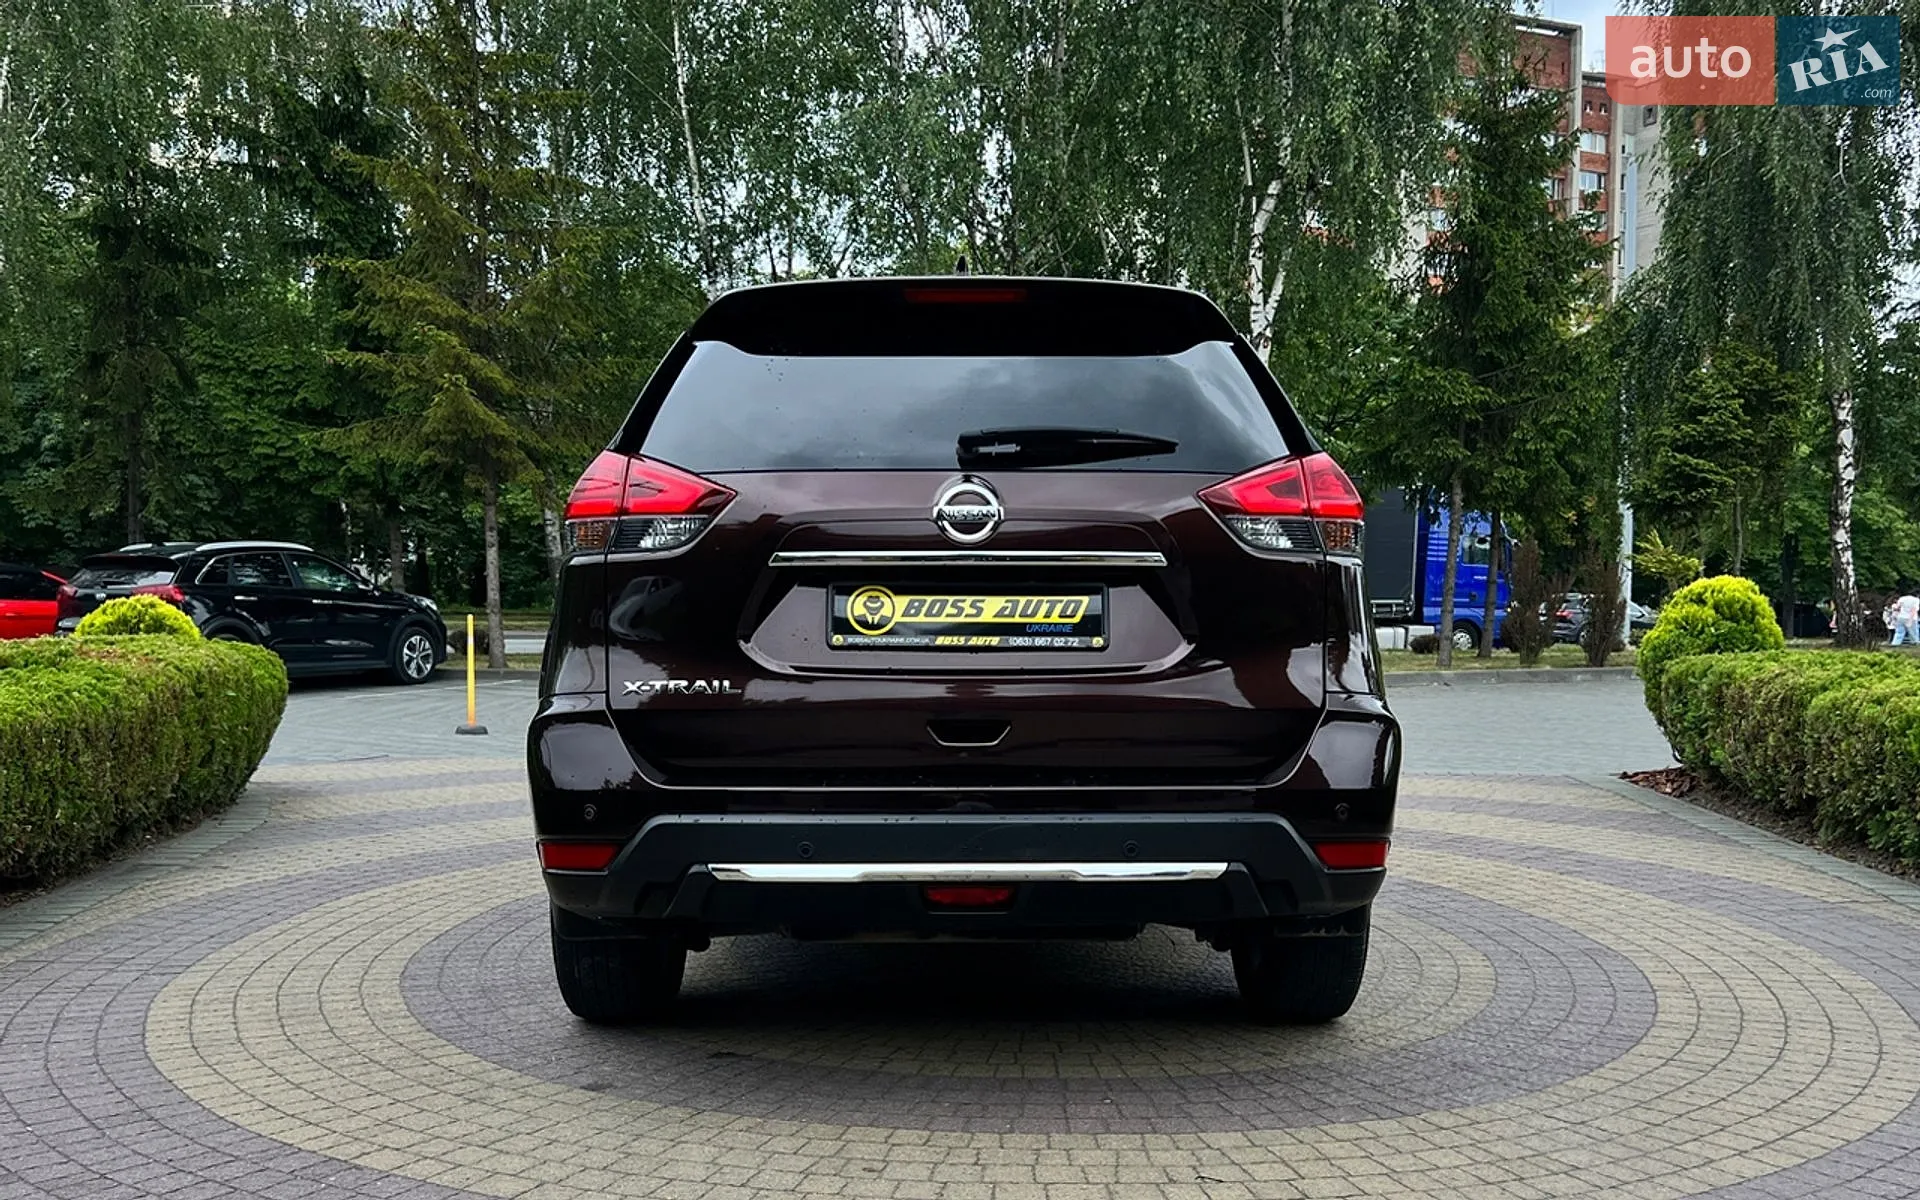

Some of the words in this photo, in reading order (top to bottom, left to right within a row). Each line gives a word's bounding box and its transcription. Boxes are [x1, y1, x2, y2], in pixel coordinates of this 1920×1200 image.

[938, 507, 998, 520] NISSAN
[902, 598, 985, 618] BOSS
[992, 598, 1083, 618] AUTO
[1026, 624, 1074, 633] UKRAINE
[934, 637, 965, 645] BOSS
[967, 637, 1000, 646] AUTO
[1053, 637, 1065, 646] 02
[1066, 637, 1080, 646] 72
[622, 680, 742, 696] X-TRAIL
